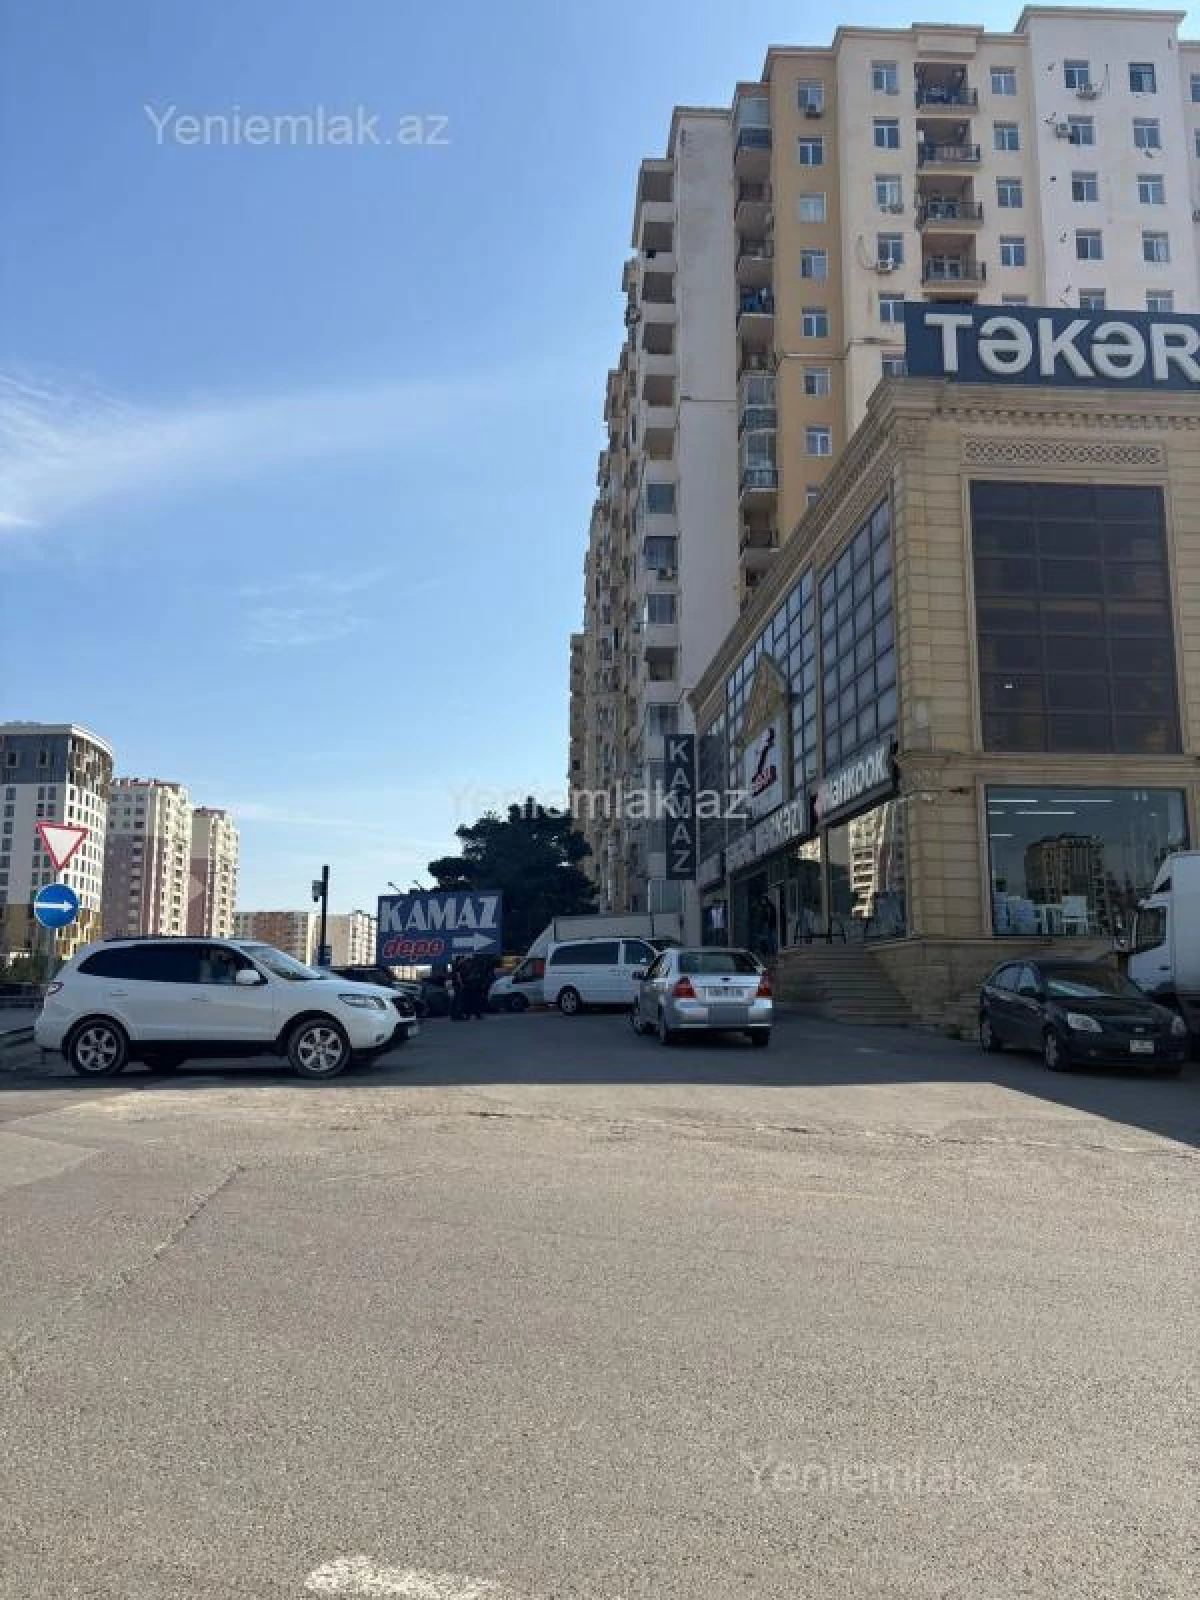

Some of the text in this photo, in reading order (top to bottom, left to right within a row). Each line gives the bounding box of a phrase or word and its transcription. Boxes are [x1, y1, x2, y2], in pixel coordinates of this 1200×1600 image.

[924, 313, 1200, 383] TƏKƏR
[669, 739, 693, 873] KAMAZ
[380, 896, 498, 932] KAMAZ
[382, 934, 445, 962] depo
